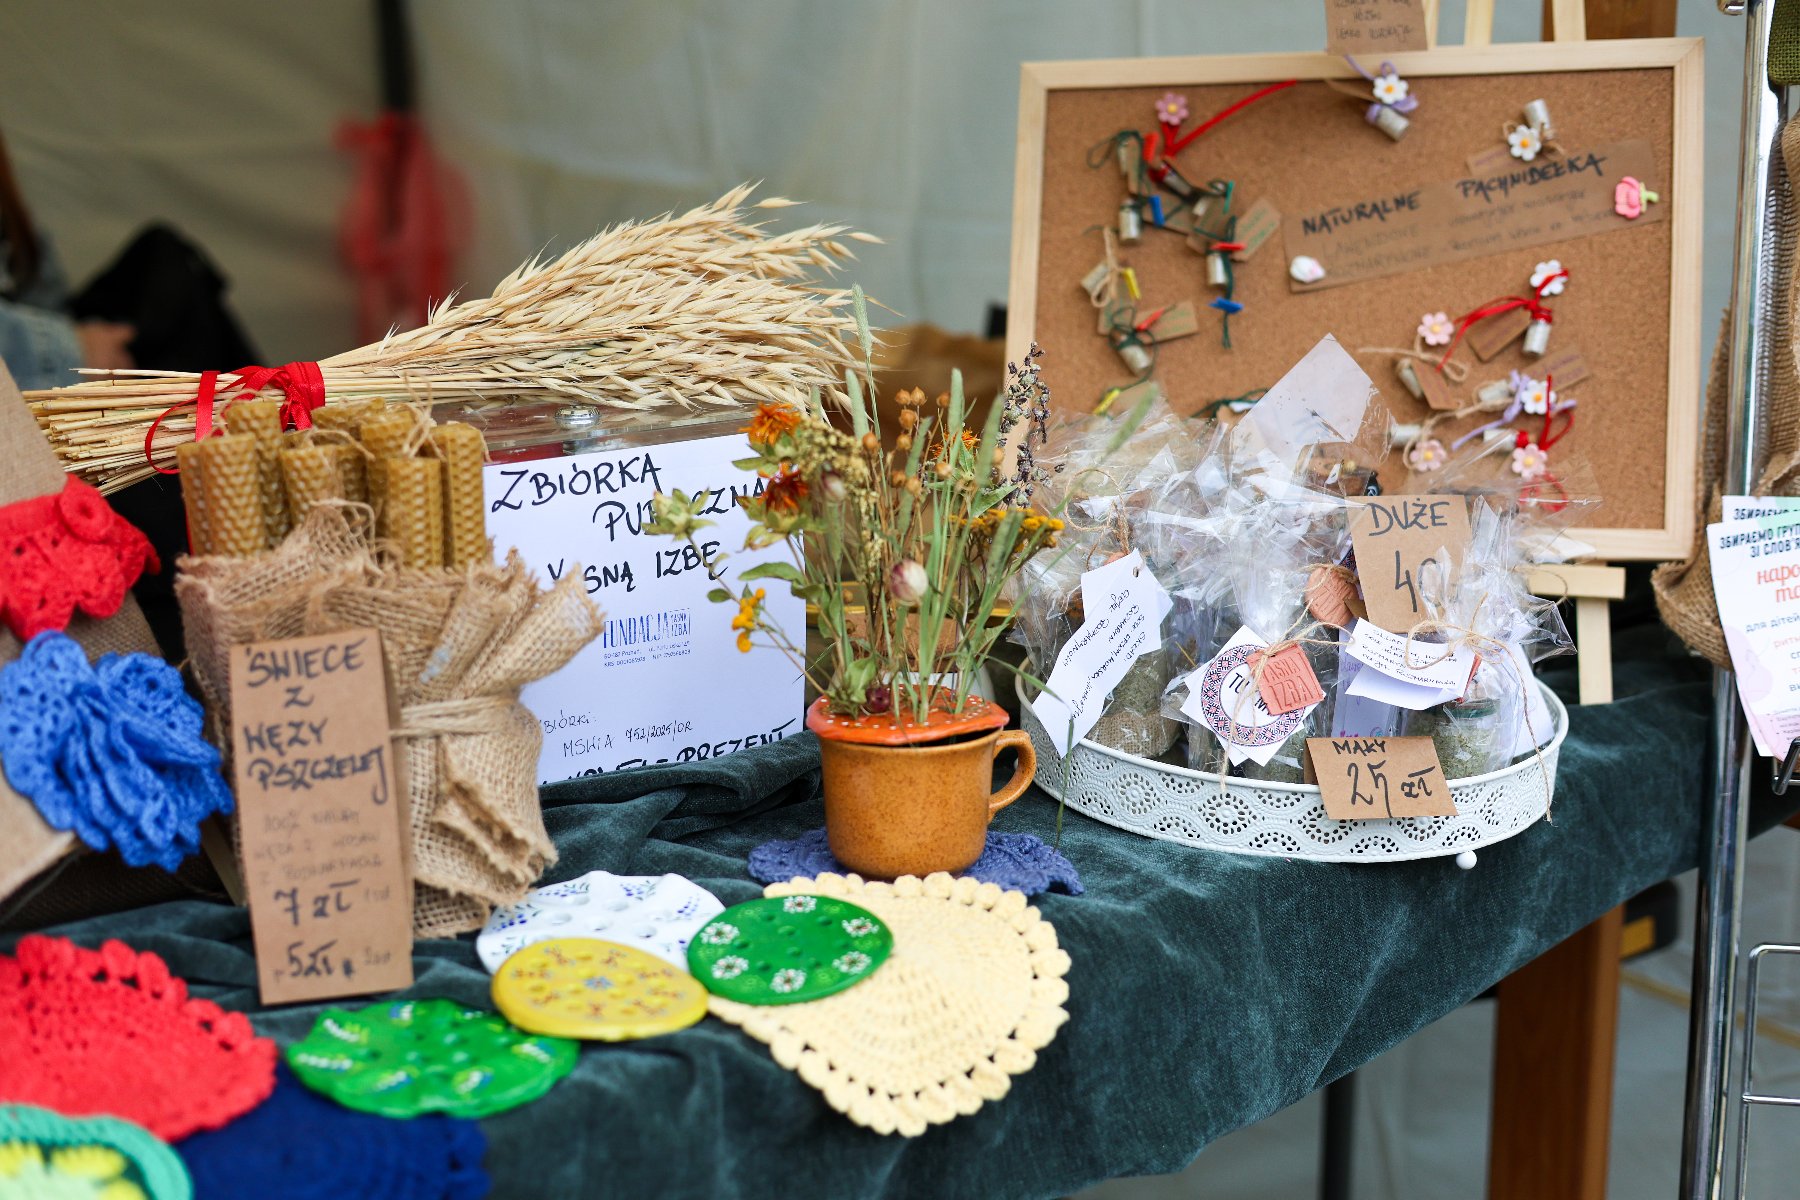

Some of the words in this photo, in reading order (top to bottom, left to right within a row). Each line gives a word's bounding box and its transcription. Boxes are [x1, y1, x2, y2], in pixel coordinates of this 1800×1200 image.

[1302, 190, 1422, 236] NATURALNE
[491, 453, 663, 513] ZBIÓRKA
[1366, 497, 1450, 537] DUŻE
[656, 541, 728, 581] IZBĘ
[603, 612, 670, 648] FUNDACJA
[246, 636, 367, 688] ŚWIECE
[1346, 760, 1393, 818] 25
[274, 887, 299, 927] 7
